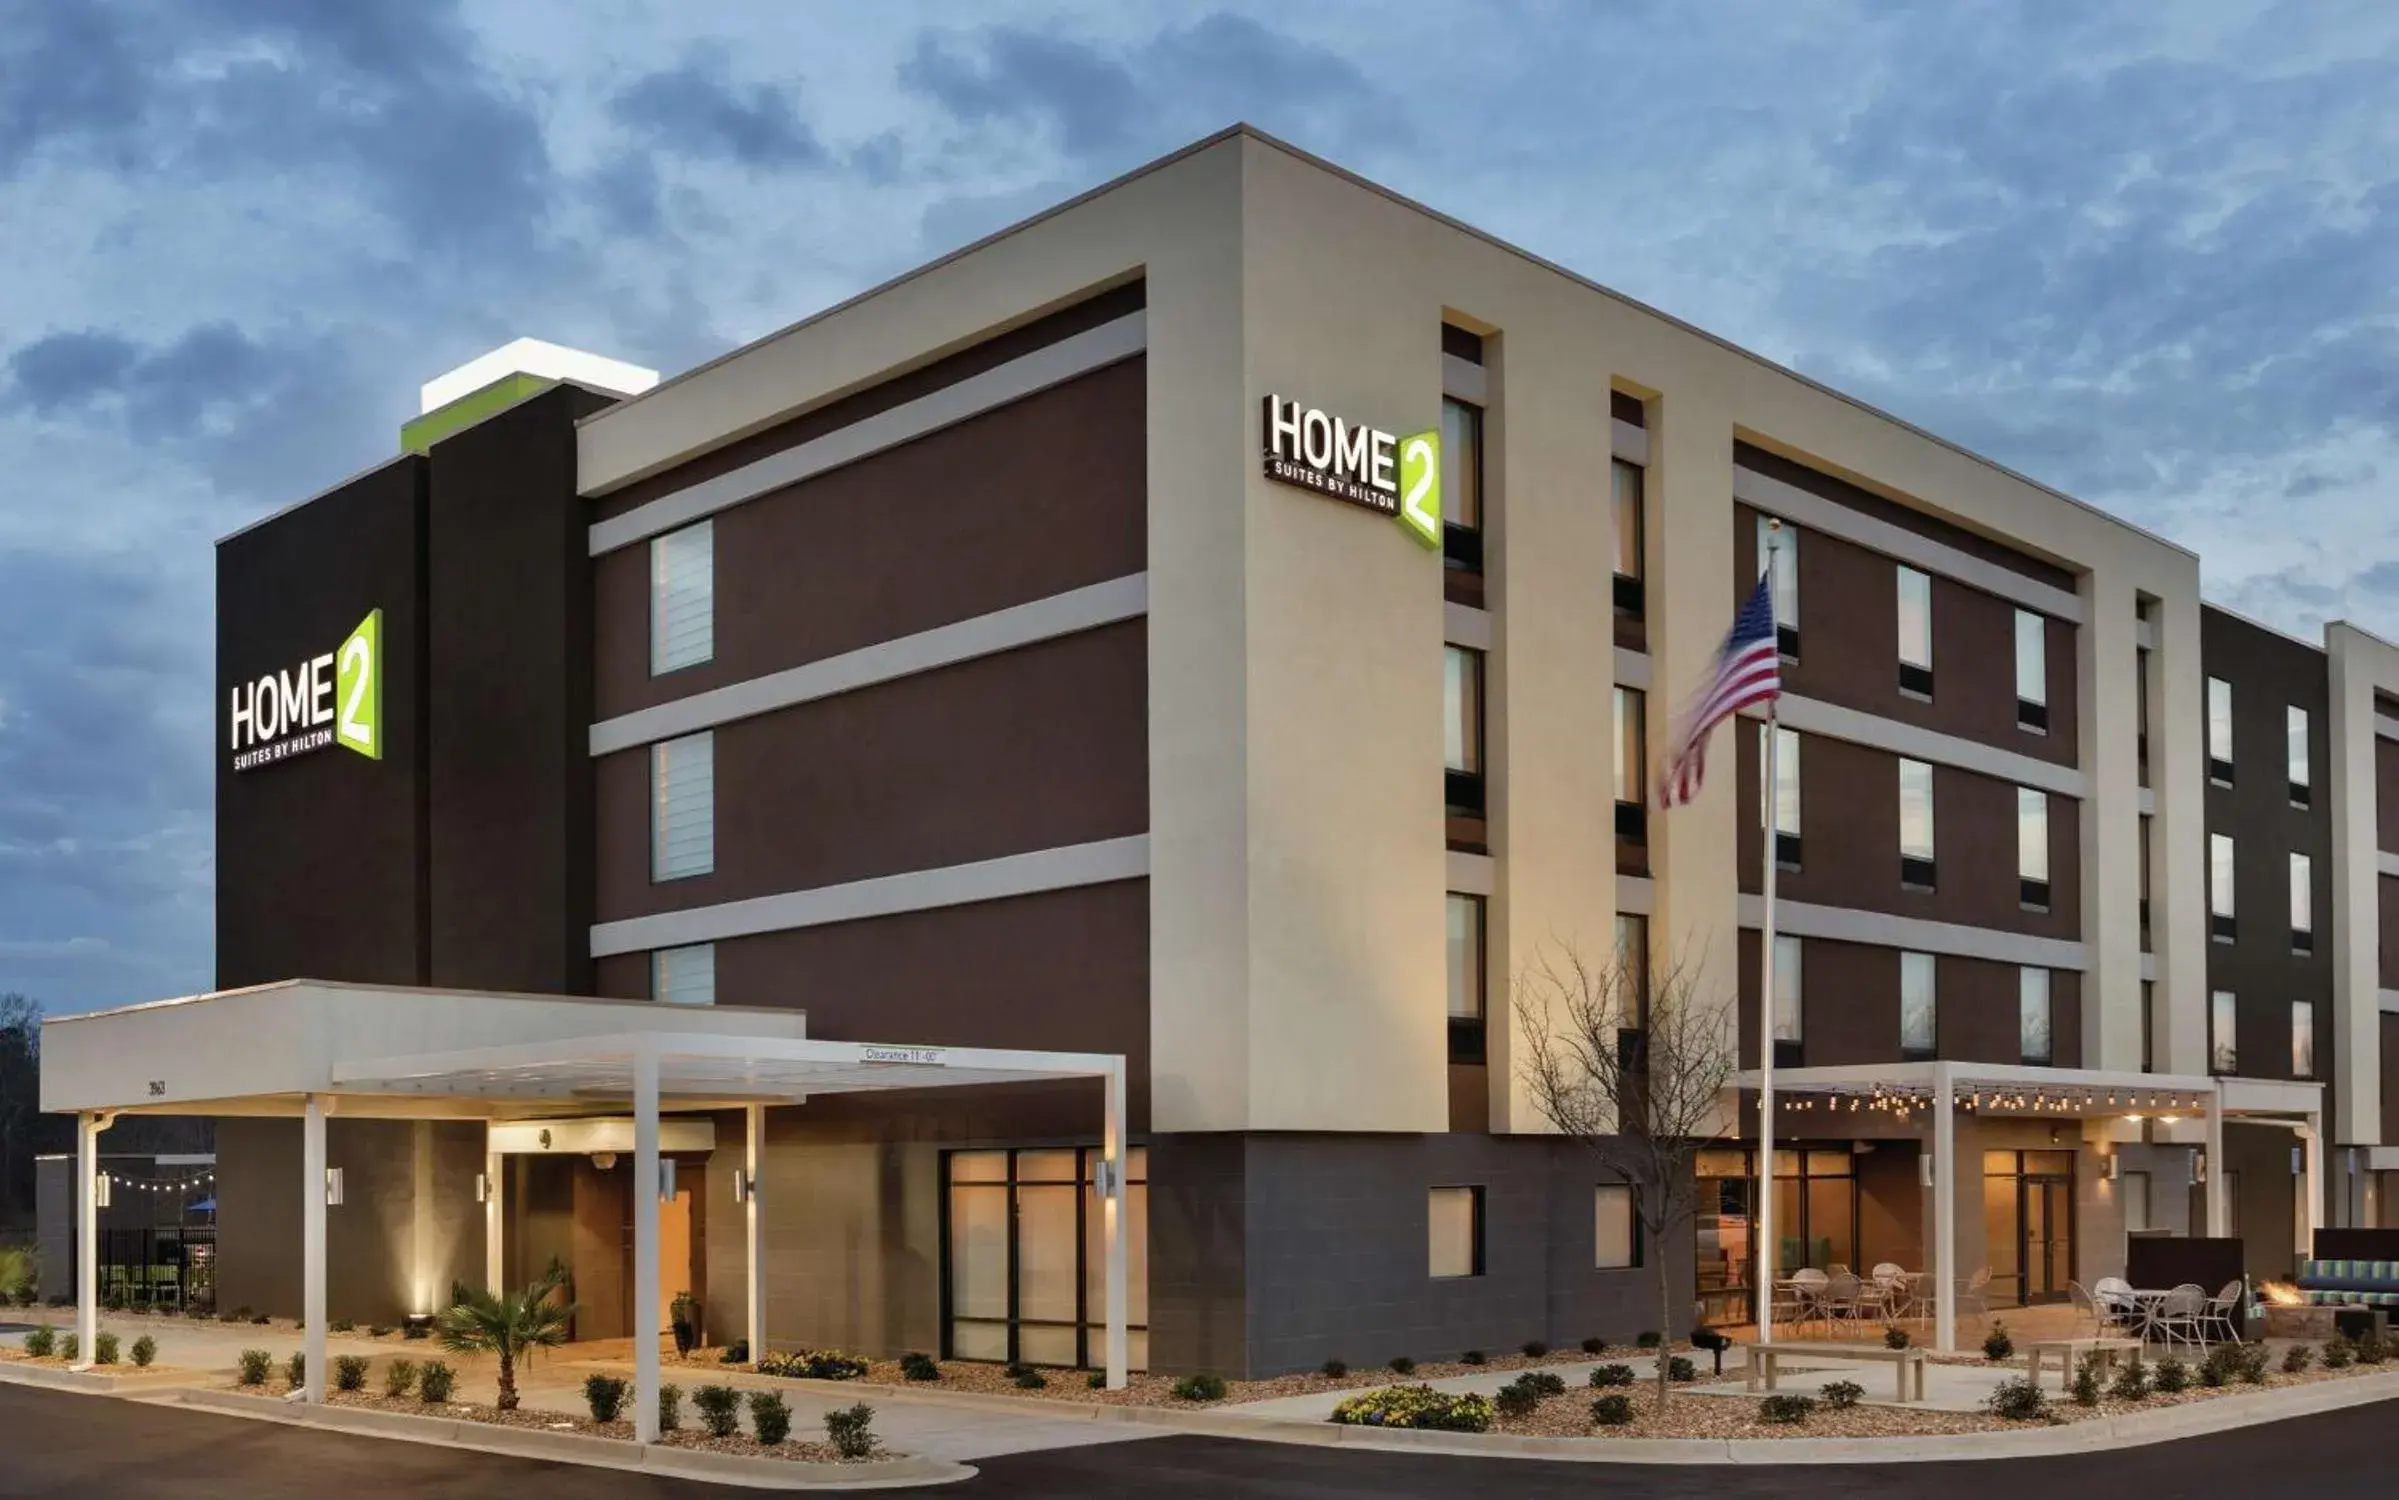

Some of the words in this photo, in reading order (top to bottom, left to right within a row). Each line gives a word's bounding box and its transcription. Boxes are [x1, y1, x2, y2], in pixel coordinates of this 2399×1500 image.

[1271, 393, 1397, 492] HOME
[1274, 461, 1323, 487] SUITES
[1328, 477, 1346, 493] BY
[1349, 485, 1395, 511] HILTON
[231, 652, 335, 750] HOME
[234, 748, 272, 771] SUITES
[274, 744, 289, 758] BY
[291, 729, 333, 753] HILTON
